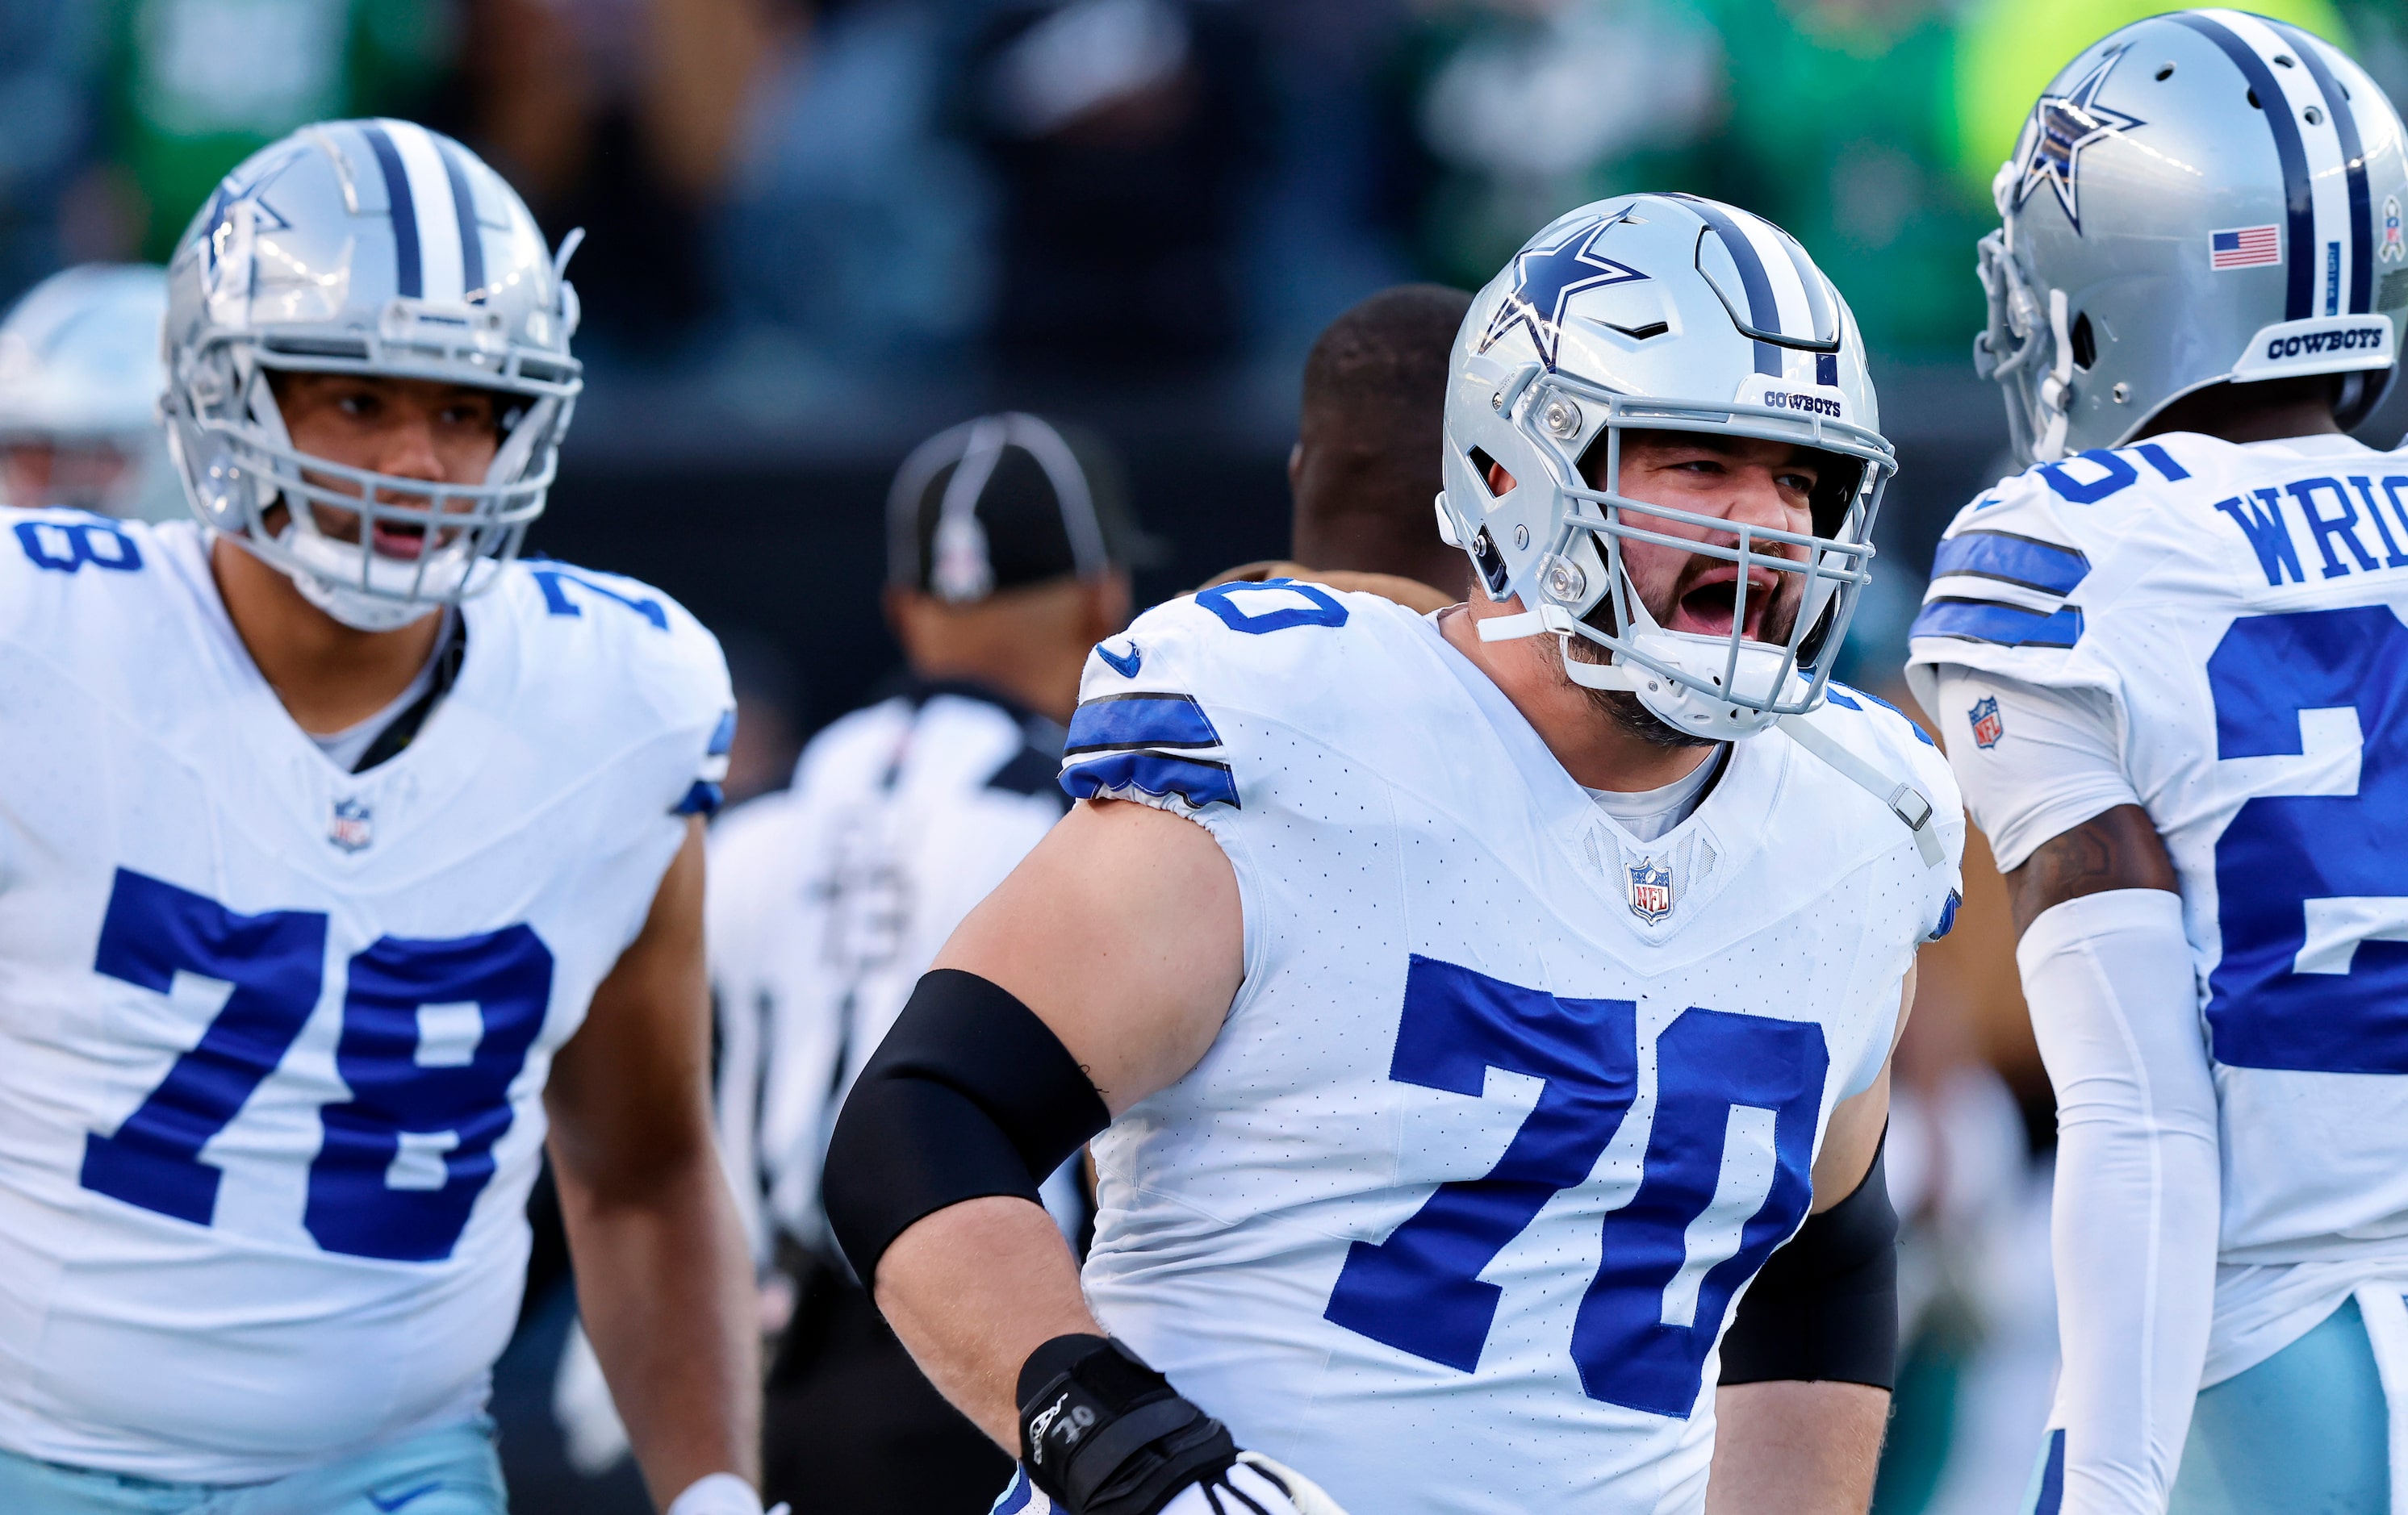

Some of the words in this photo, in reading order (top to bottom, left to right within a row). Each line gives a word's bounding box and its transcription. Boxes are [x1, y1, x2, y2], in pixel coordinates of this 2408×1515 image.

[2268, 329, 2382, 359] COWBOYS
[1764, 390, 1841, 418] COWBOYS
[1975, 716, 2001, 744] NFL
[1636, 886, 1667, 912] NFL
[78, 866, 554, 1261] 78
[1323, 953, 1829, 1419] 70
[1051, 1404, 1095, 1445] 70
